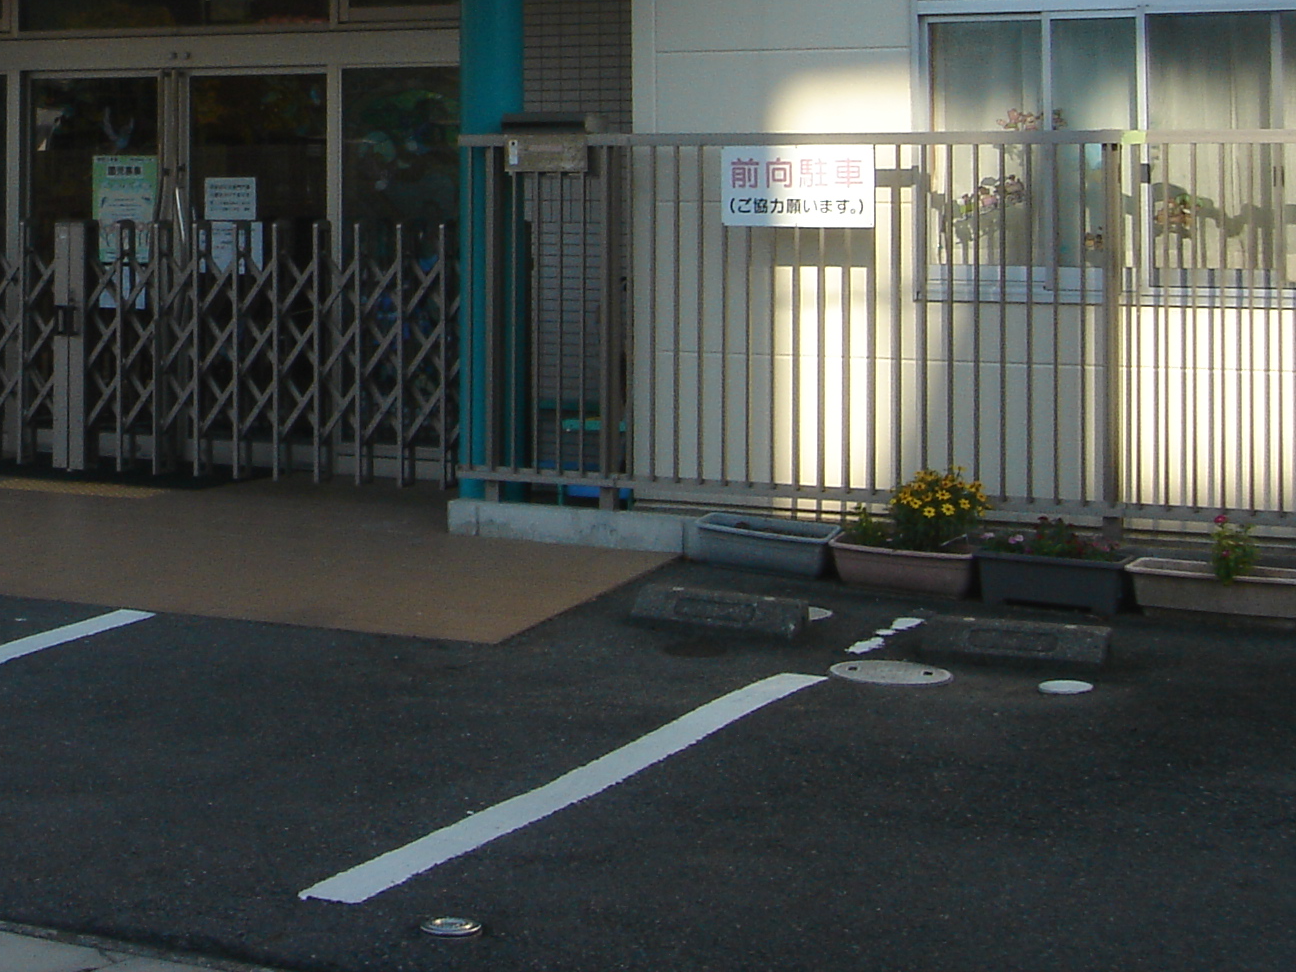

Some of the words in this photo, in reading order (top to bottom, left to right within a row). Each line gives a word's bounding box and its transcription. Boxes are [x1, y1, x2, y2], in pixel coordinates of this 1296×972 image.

[730, 157, 864, 188] 前向駐車
[730, 197, 864, 215] (ご協力願います。)
